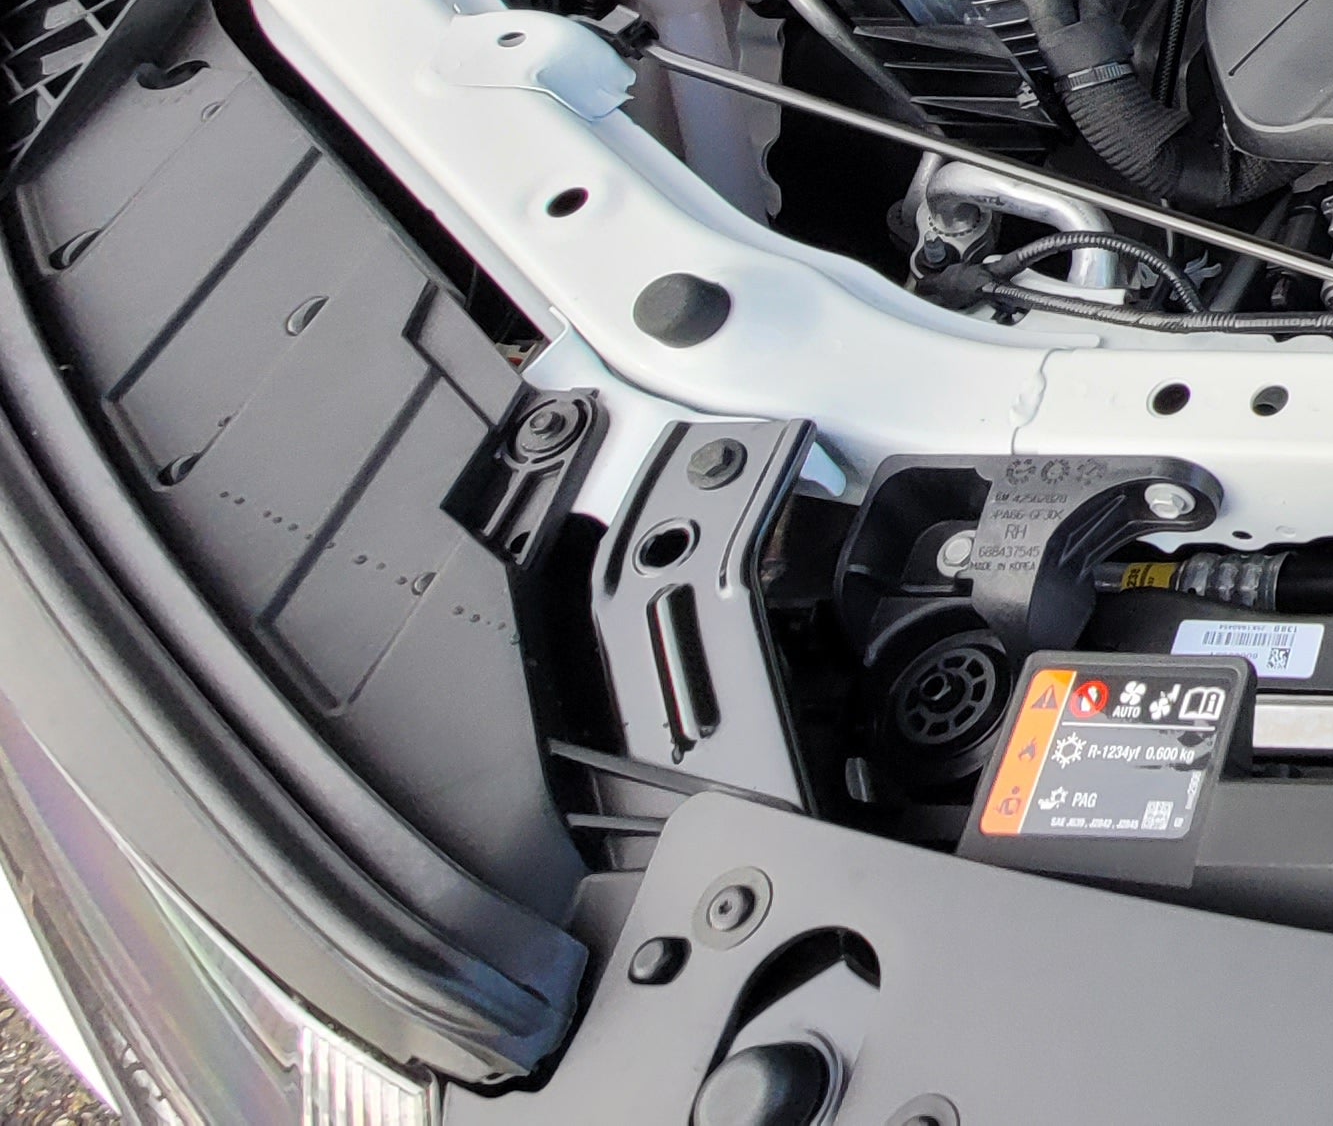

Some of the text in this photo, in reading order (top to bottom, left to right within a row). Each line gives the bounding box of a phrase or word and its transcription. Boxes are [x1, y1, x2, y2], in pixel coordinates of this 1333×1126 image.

[1004, 524, 1027, 540] RH
[1112, 705, 1141, 718] AUTO
[1087, 745, 1195, 764] R-1234yf 0.600 kg
[1072, 793, 1098, 808] PAG
